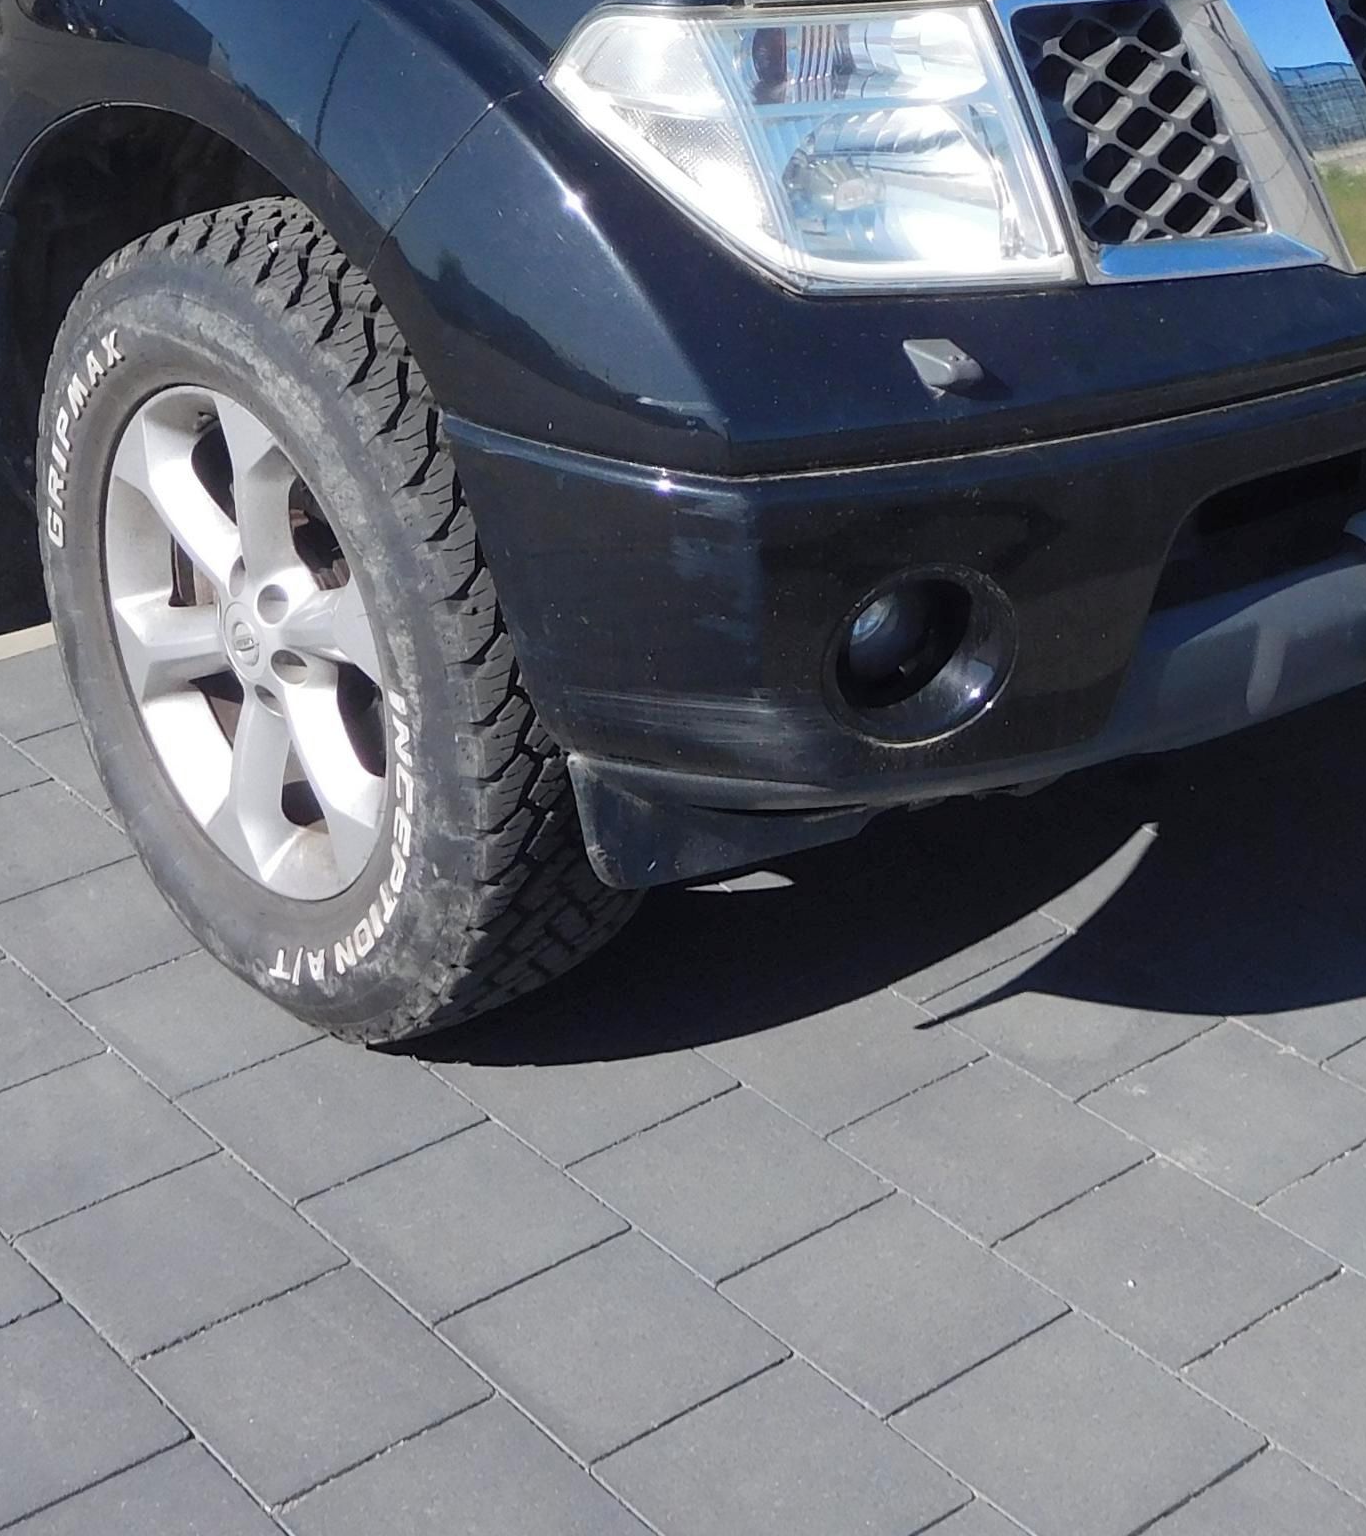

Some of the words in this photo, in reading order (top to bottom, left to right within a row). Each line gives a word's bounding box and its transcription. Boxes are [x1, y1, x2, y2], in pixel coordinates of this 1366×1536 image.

[47, 328, 123, 548] GRIPMAX
[335, 689, 414, 975] INCEPTION
[268, 946, 326, 986] A/T
